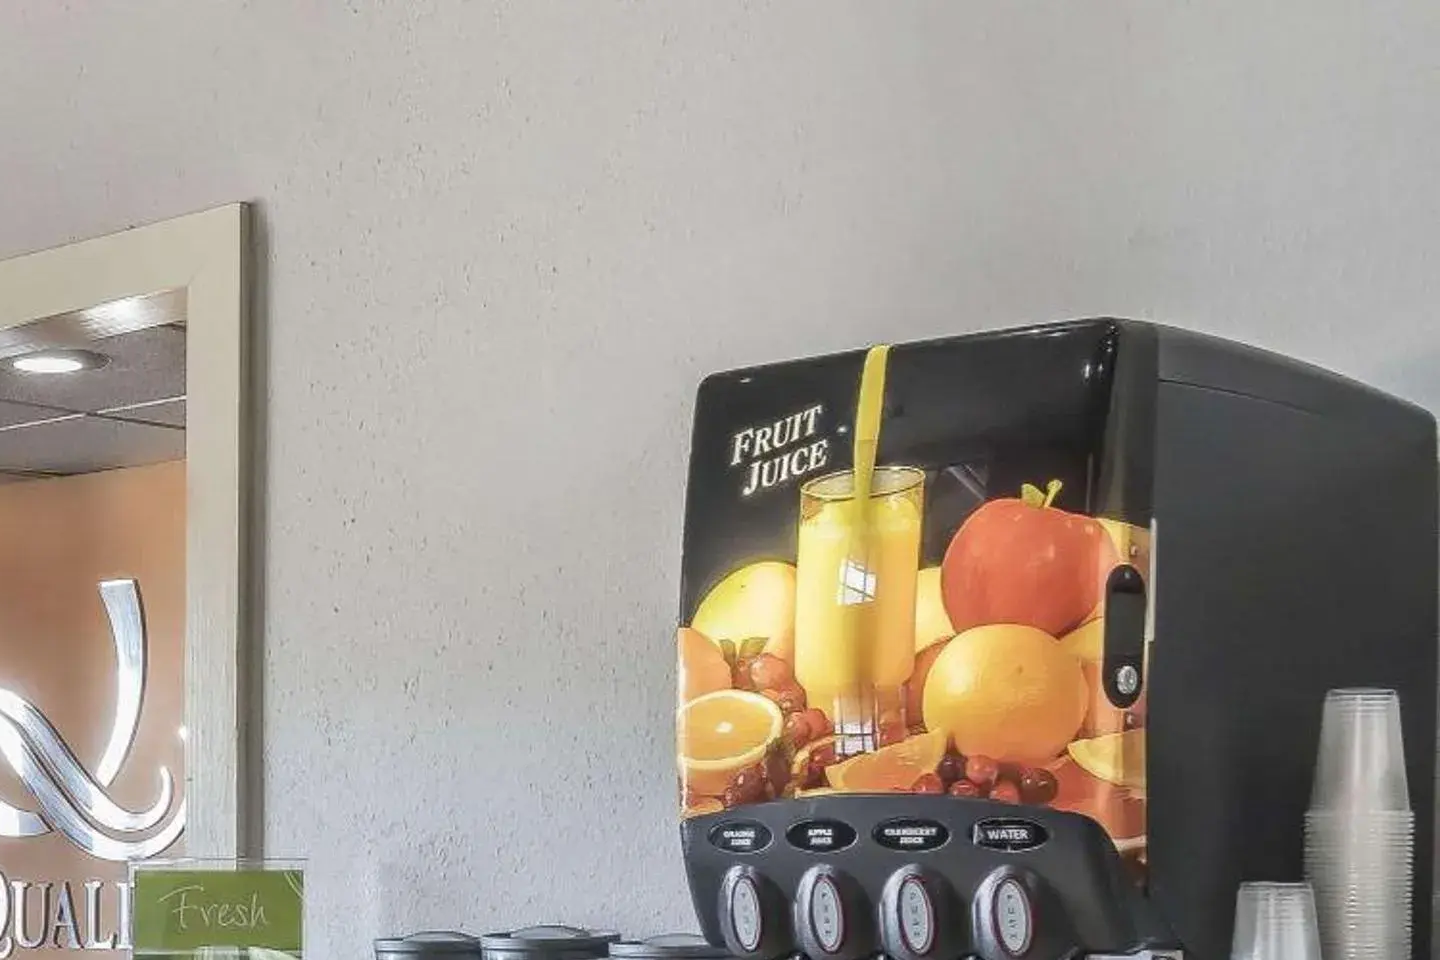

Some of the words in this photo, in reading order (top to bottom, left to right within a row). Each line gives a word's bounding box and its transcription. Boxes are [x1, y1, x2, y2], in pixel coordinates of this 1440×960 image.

[730, 404, 823, 466] FRUIT
[742, 439, 828, 496] JUICE
[987, 828, 1030, 841] WATER
[158, 884, 269, 931] Fresh
